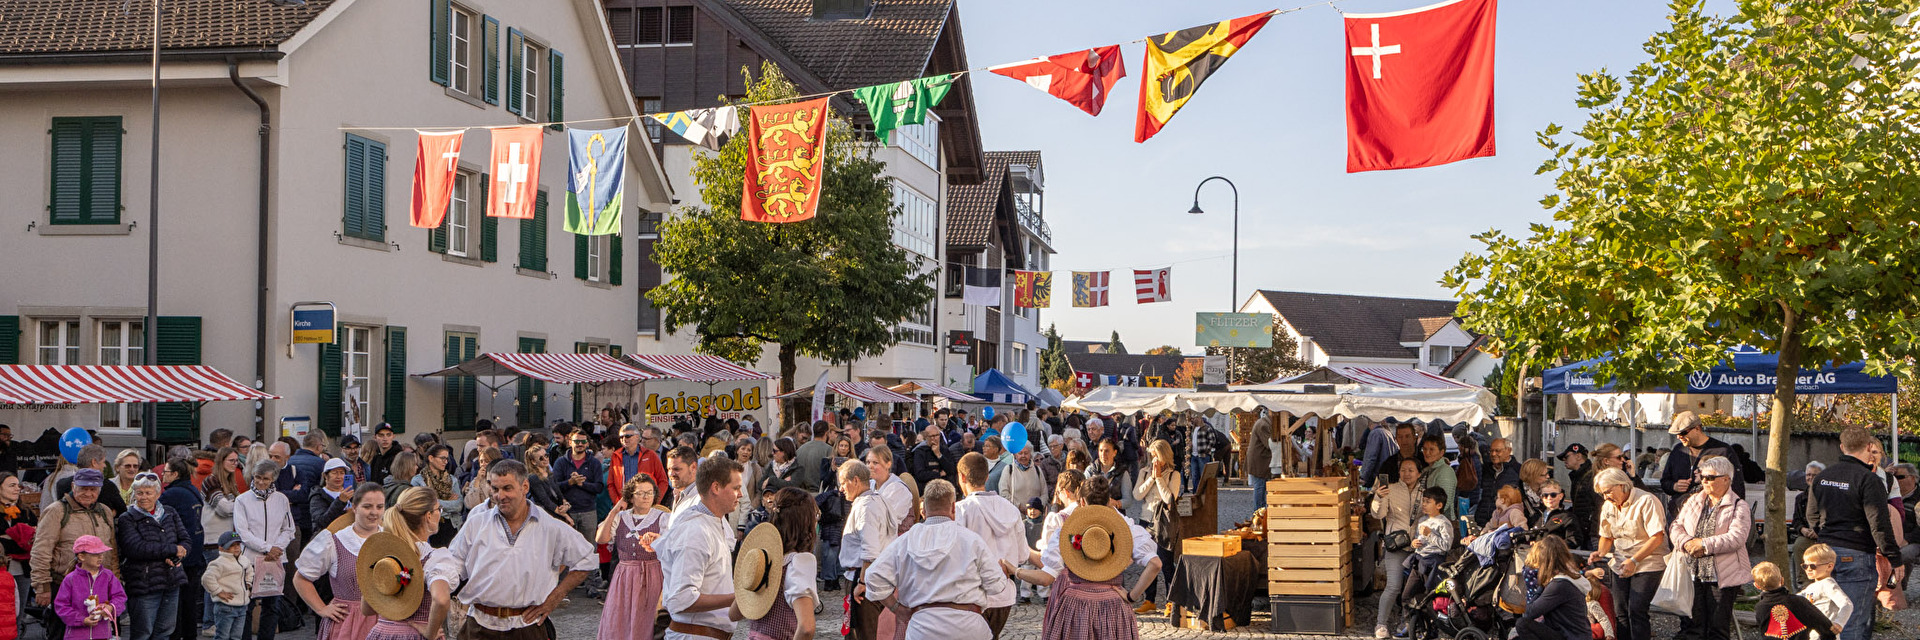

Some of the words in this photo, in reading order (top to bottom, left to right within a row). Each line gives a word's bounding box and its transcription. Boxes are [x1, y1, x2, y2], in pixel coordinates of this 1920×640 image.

[1210, 317, 1258, 327] FLITZER
[1718, 374, 1753, 385] Auto
[1757, 373, 1812, 385] Braer
[1815, 372, 1836, 384] AG
[645, 386, 762, 419] Maisgold
[721, 412, 740, 420] BIER
